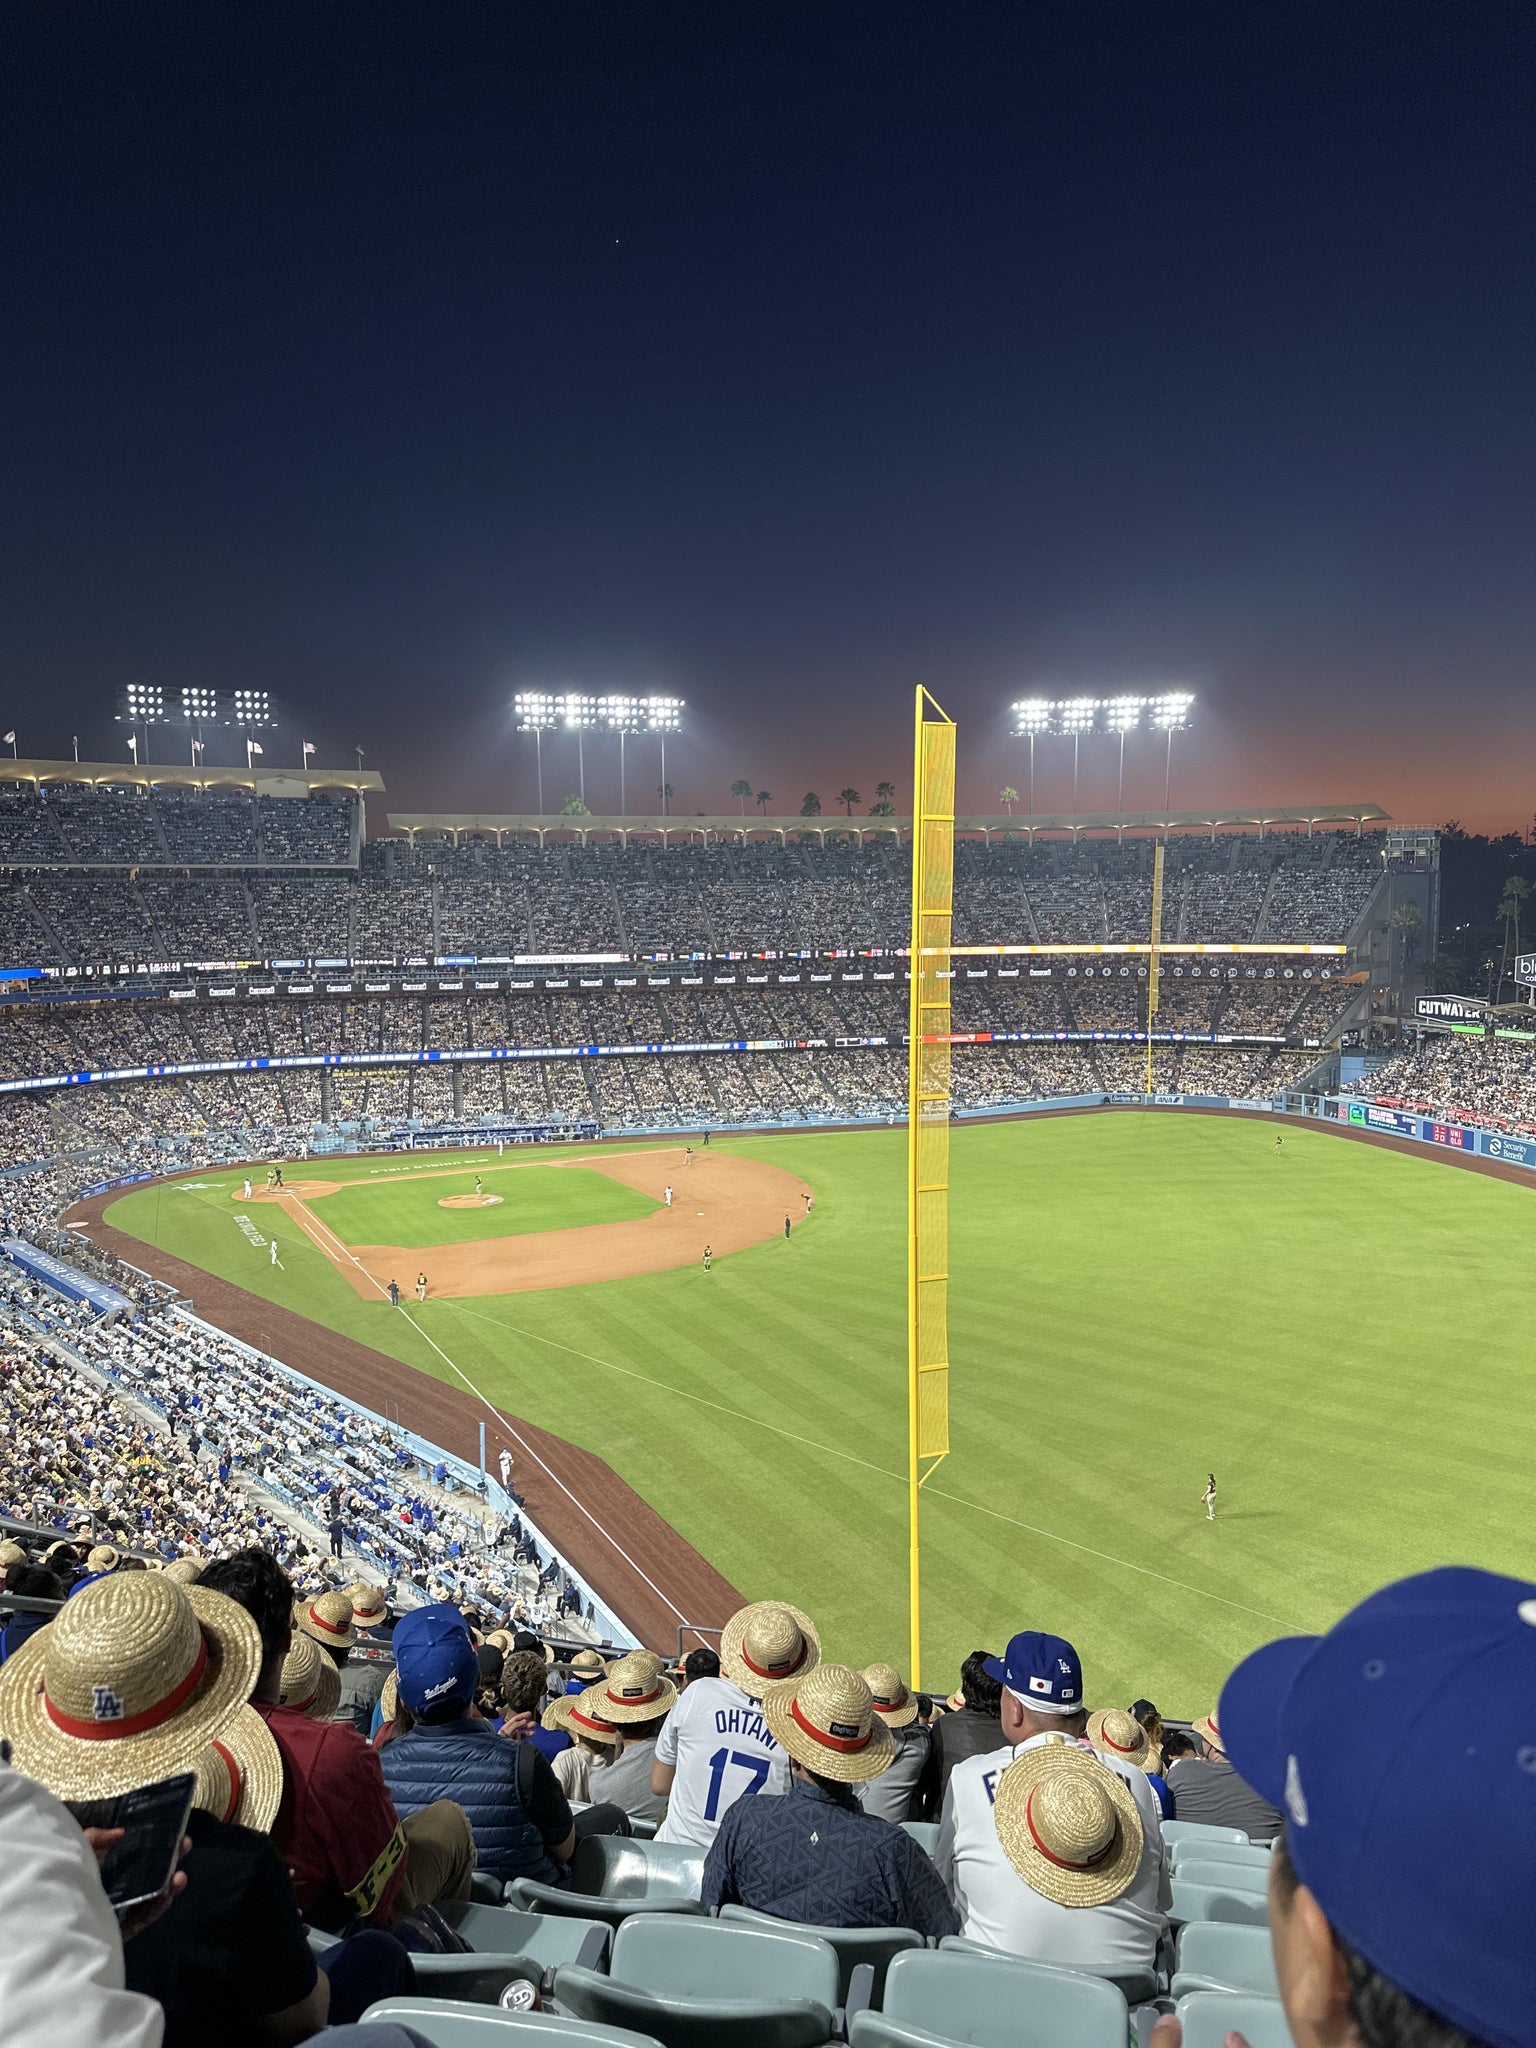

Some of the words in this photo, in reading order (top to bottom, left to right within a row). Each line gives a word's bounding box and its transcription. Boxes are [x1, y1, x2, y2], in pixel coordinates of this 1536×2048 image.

[1418, 1000, 1480, 1019] CUTWATER
[1503, 1140, 1528, 1154] Security
[1503, 1149, 1524, 1162] Benefit
[1058, 1659, 1071, 1673] LA
[93, 1687, 122, 1718] LA
[704, 1747, 770, 1822] 17
